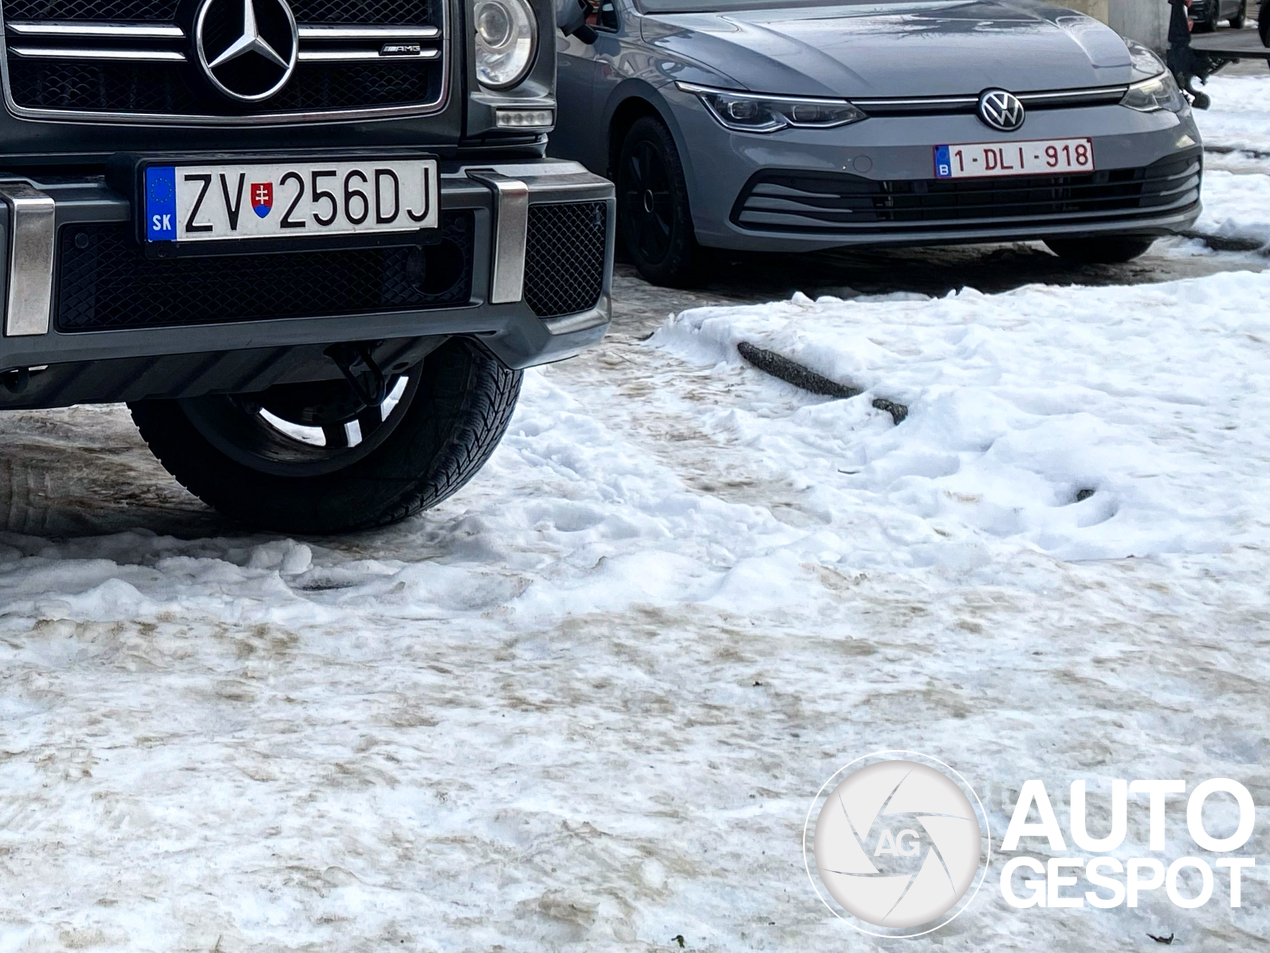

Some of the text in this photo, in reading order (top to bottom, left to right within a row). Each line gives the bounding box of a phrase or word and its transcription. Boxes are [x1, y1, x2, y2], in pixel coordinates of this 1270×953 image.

[939, 164, 949, 176] B
[183, 167, 430, 233] ZV 256DJ
[152, 214, 172, 231] SK
